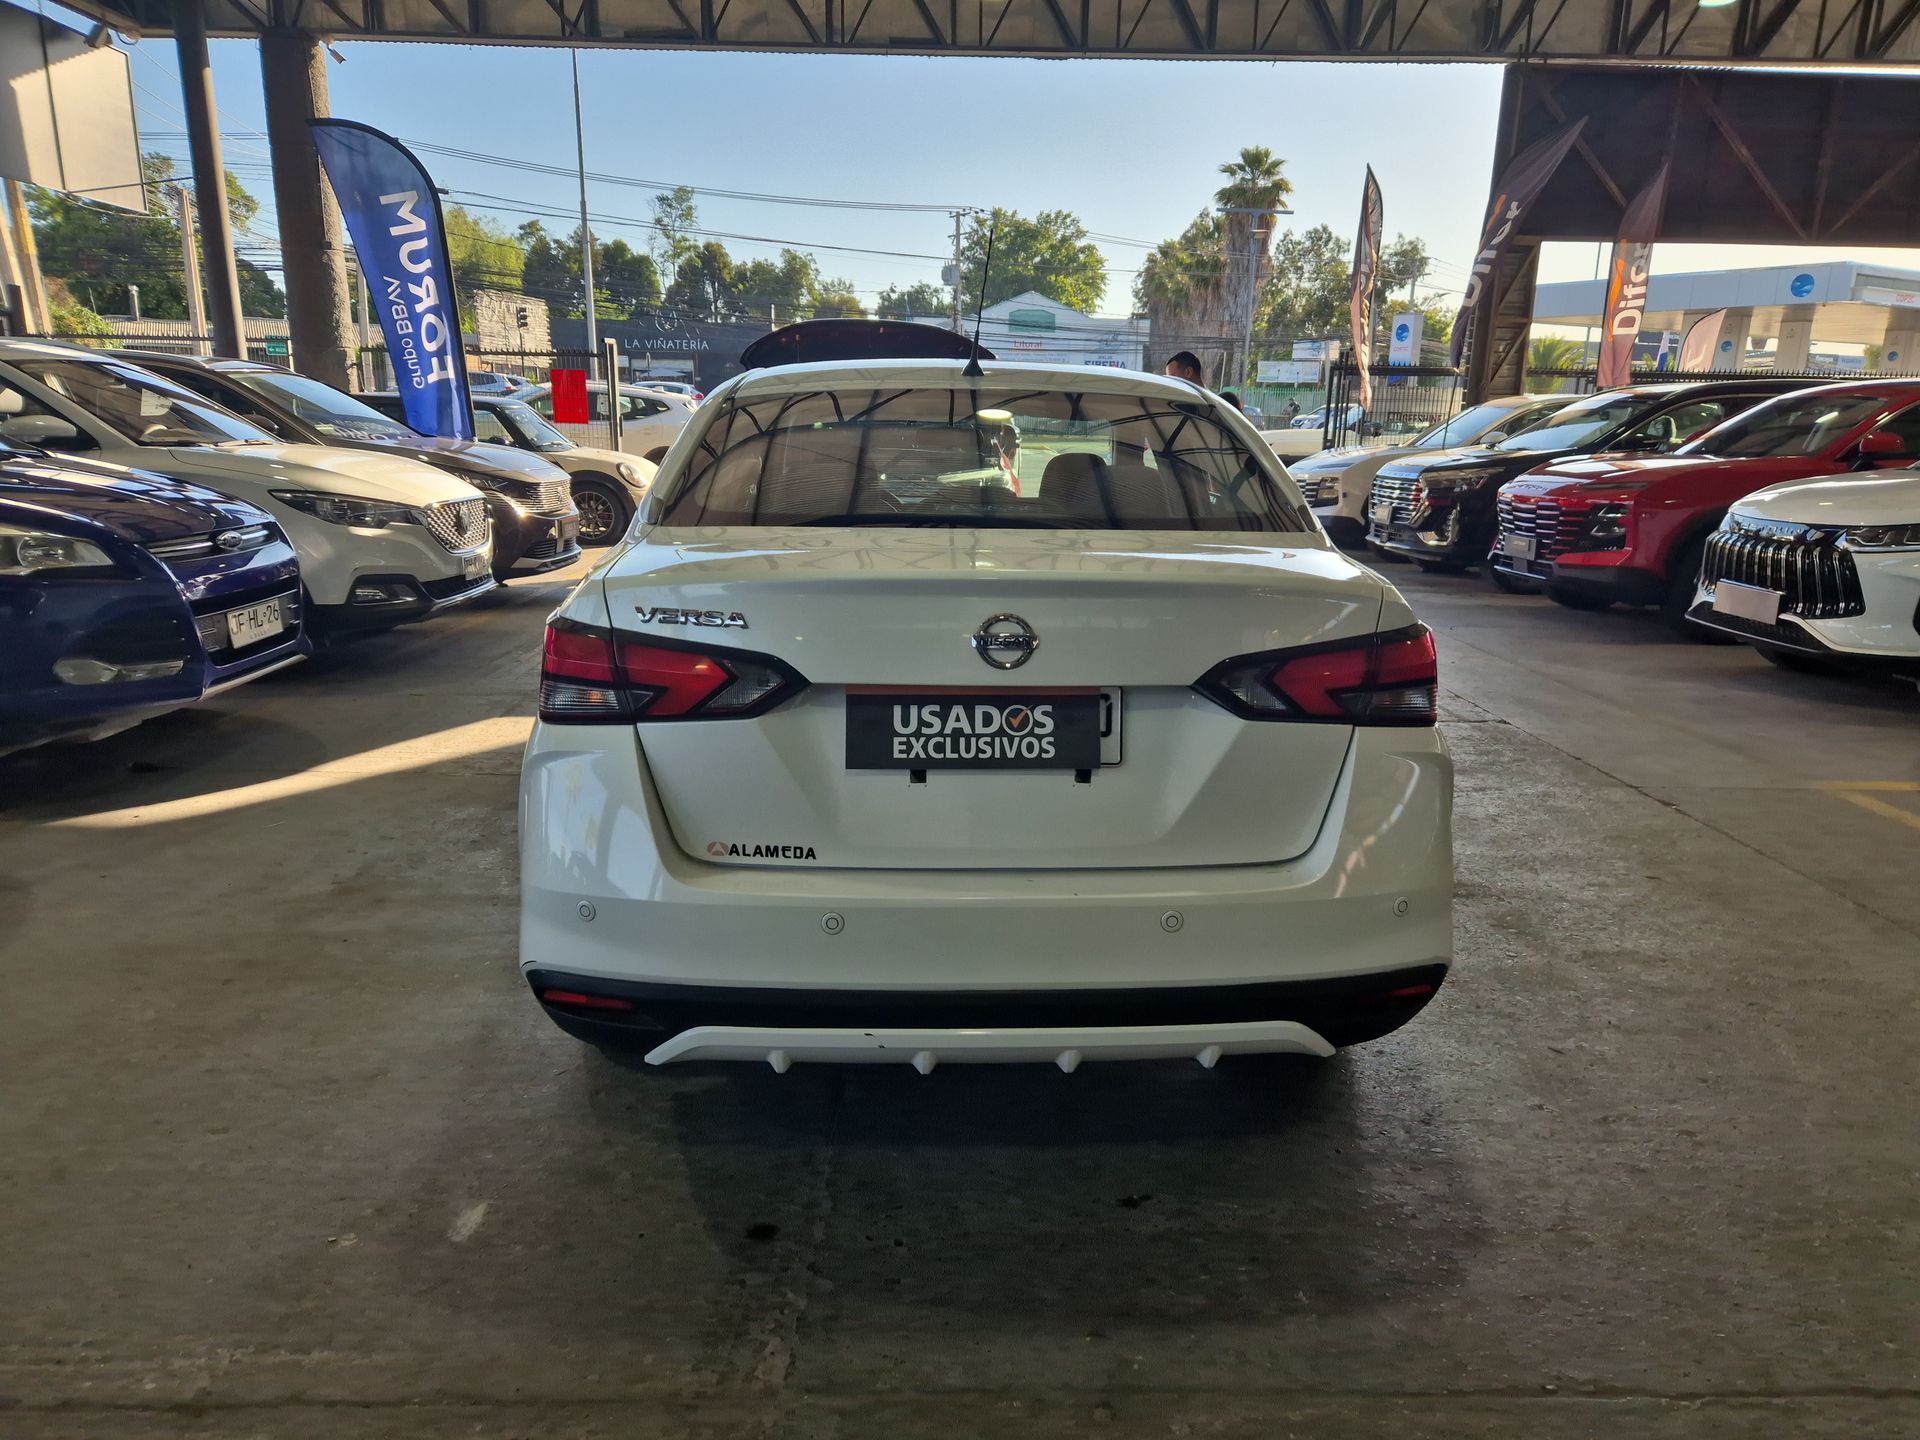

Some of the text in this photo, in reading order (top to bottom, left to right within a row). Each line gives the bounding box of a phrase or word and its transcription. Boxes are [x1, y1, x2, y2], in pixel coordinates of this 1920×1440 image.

[624, 337, 709, 350] LA VIÑATERÍA
[634, 606, 749, 630] VERSA
[979, 636, 1032, 648] NISSAN
[892, 704, 1055, 736] USADOS
[892, 736, 1056, 759] EXCLUSIVOS
[728, 843, 817, 860] ALAMEDA
